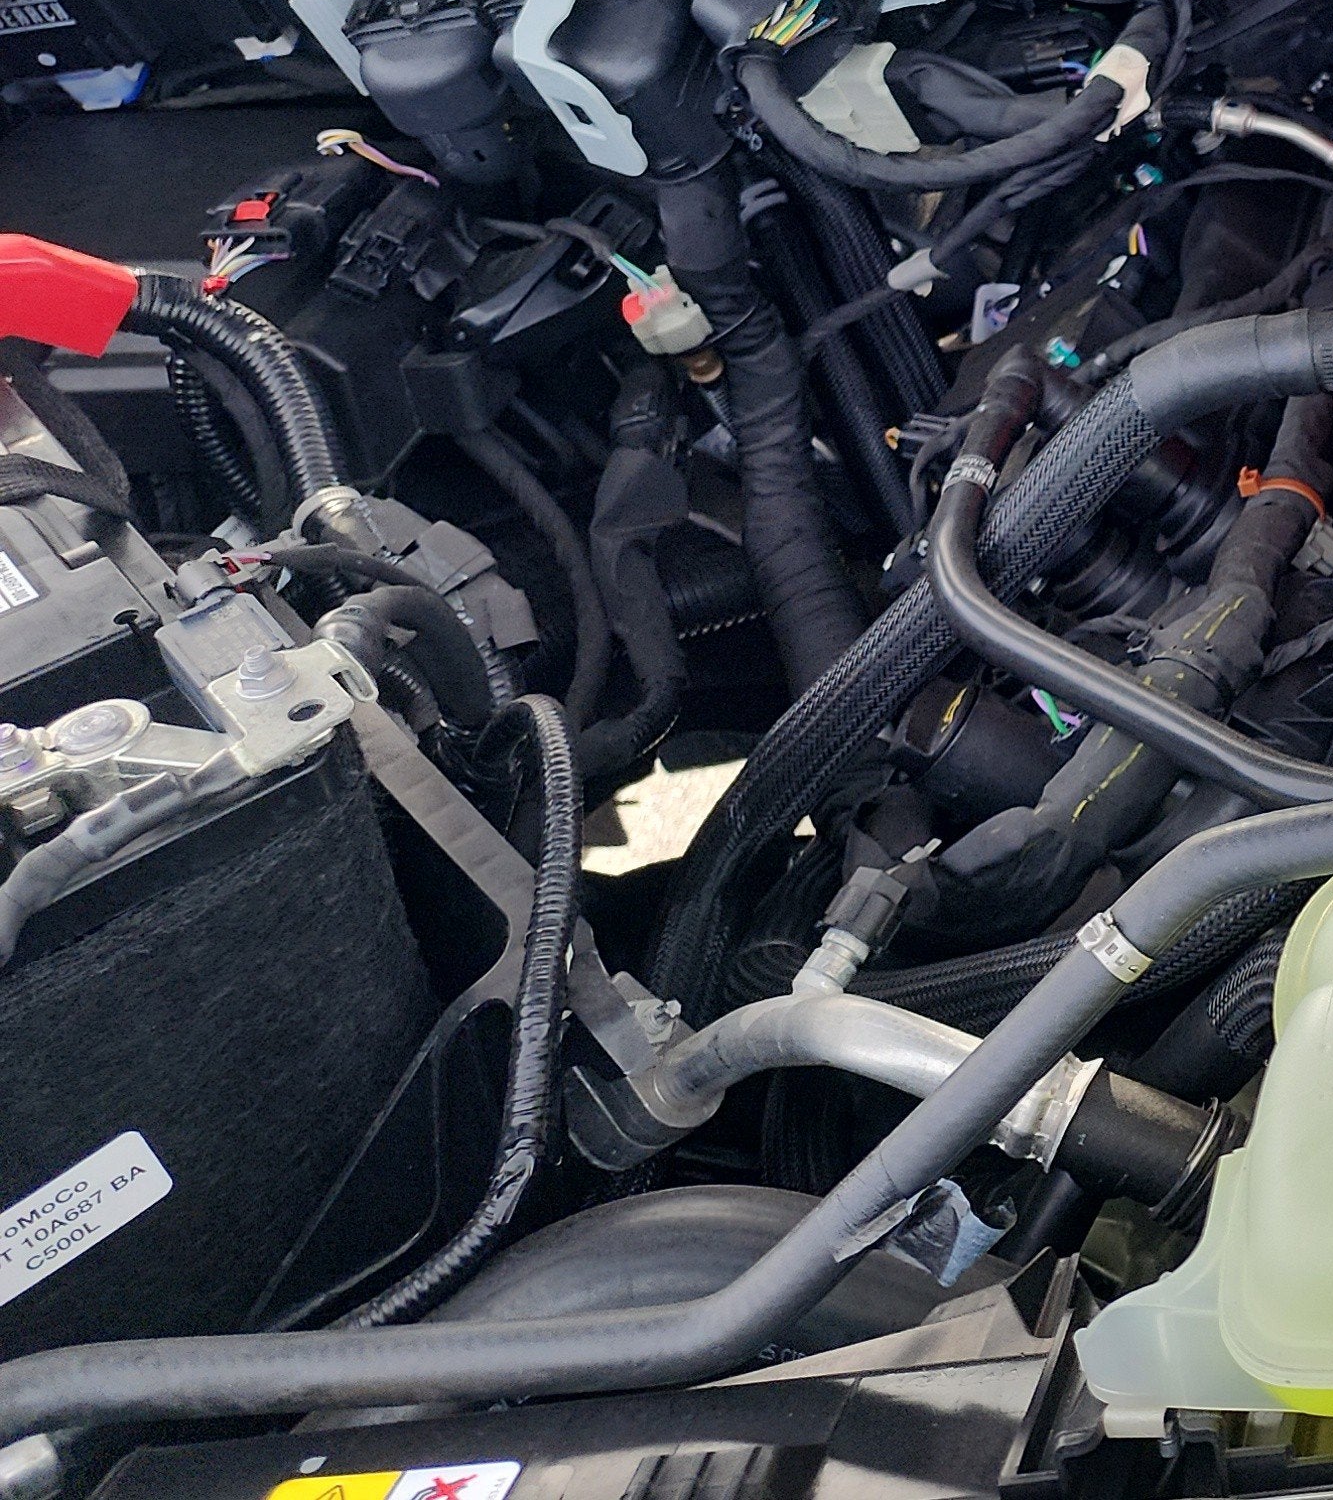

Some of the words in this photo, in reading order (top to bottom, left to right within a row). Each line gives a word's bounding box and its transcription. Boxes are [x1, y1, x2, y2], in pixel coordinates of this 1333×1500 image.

[0, 1180, 89, 1239] oMoCo
[21, 1189, 104, 1249] 10A687
[110, 1164, 147, 1192] BA
[26, 1222, 102, 1271] C500L
